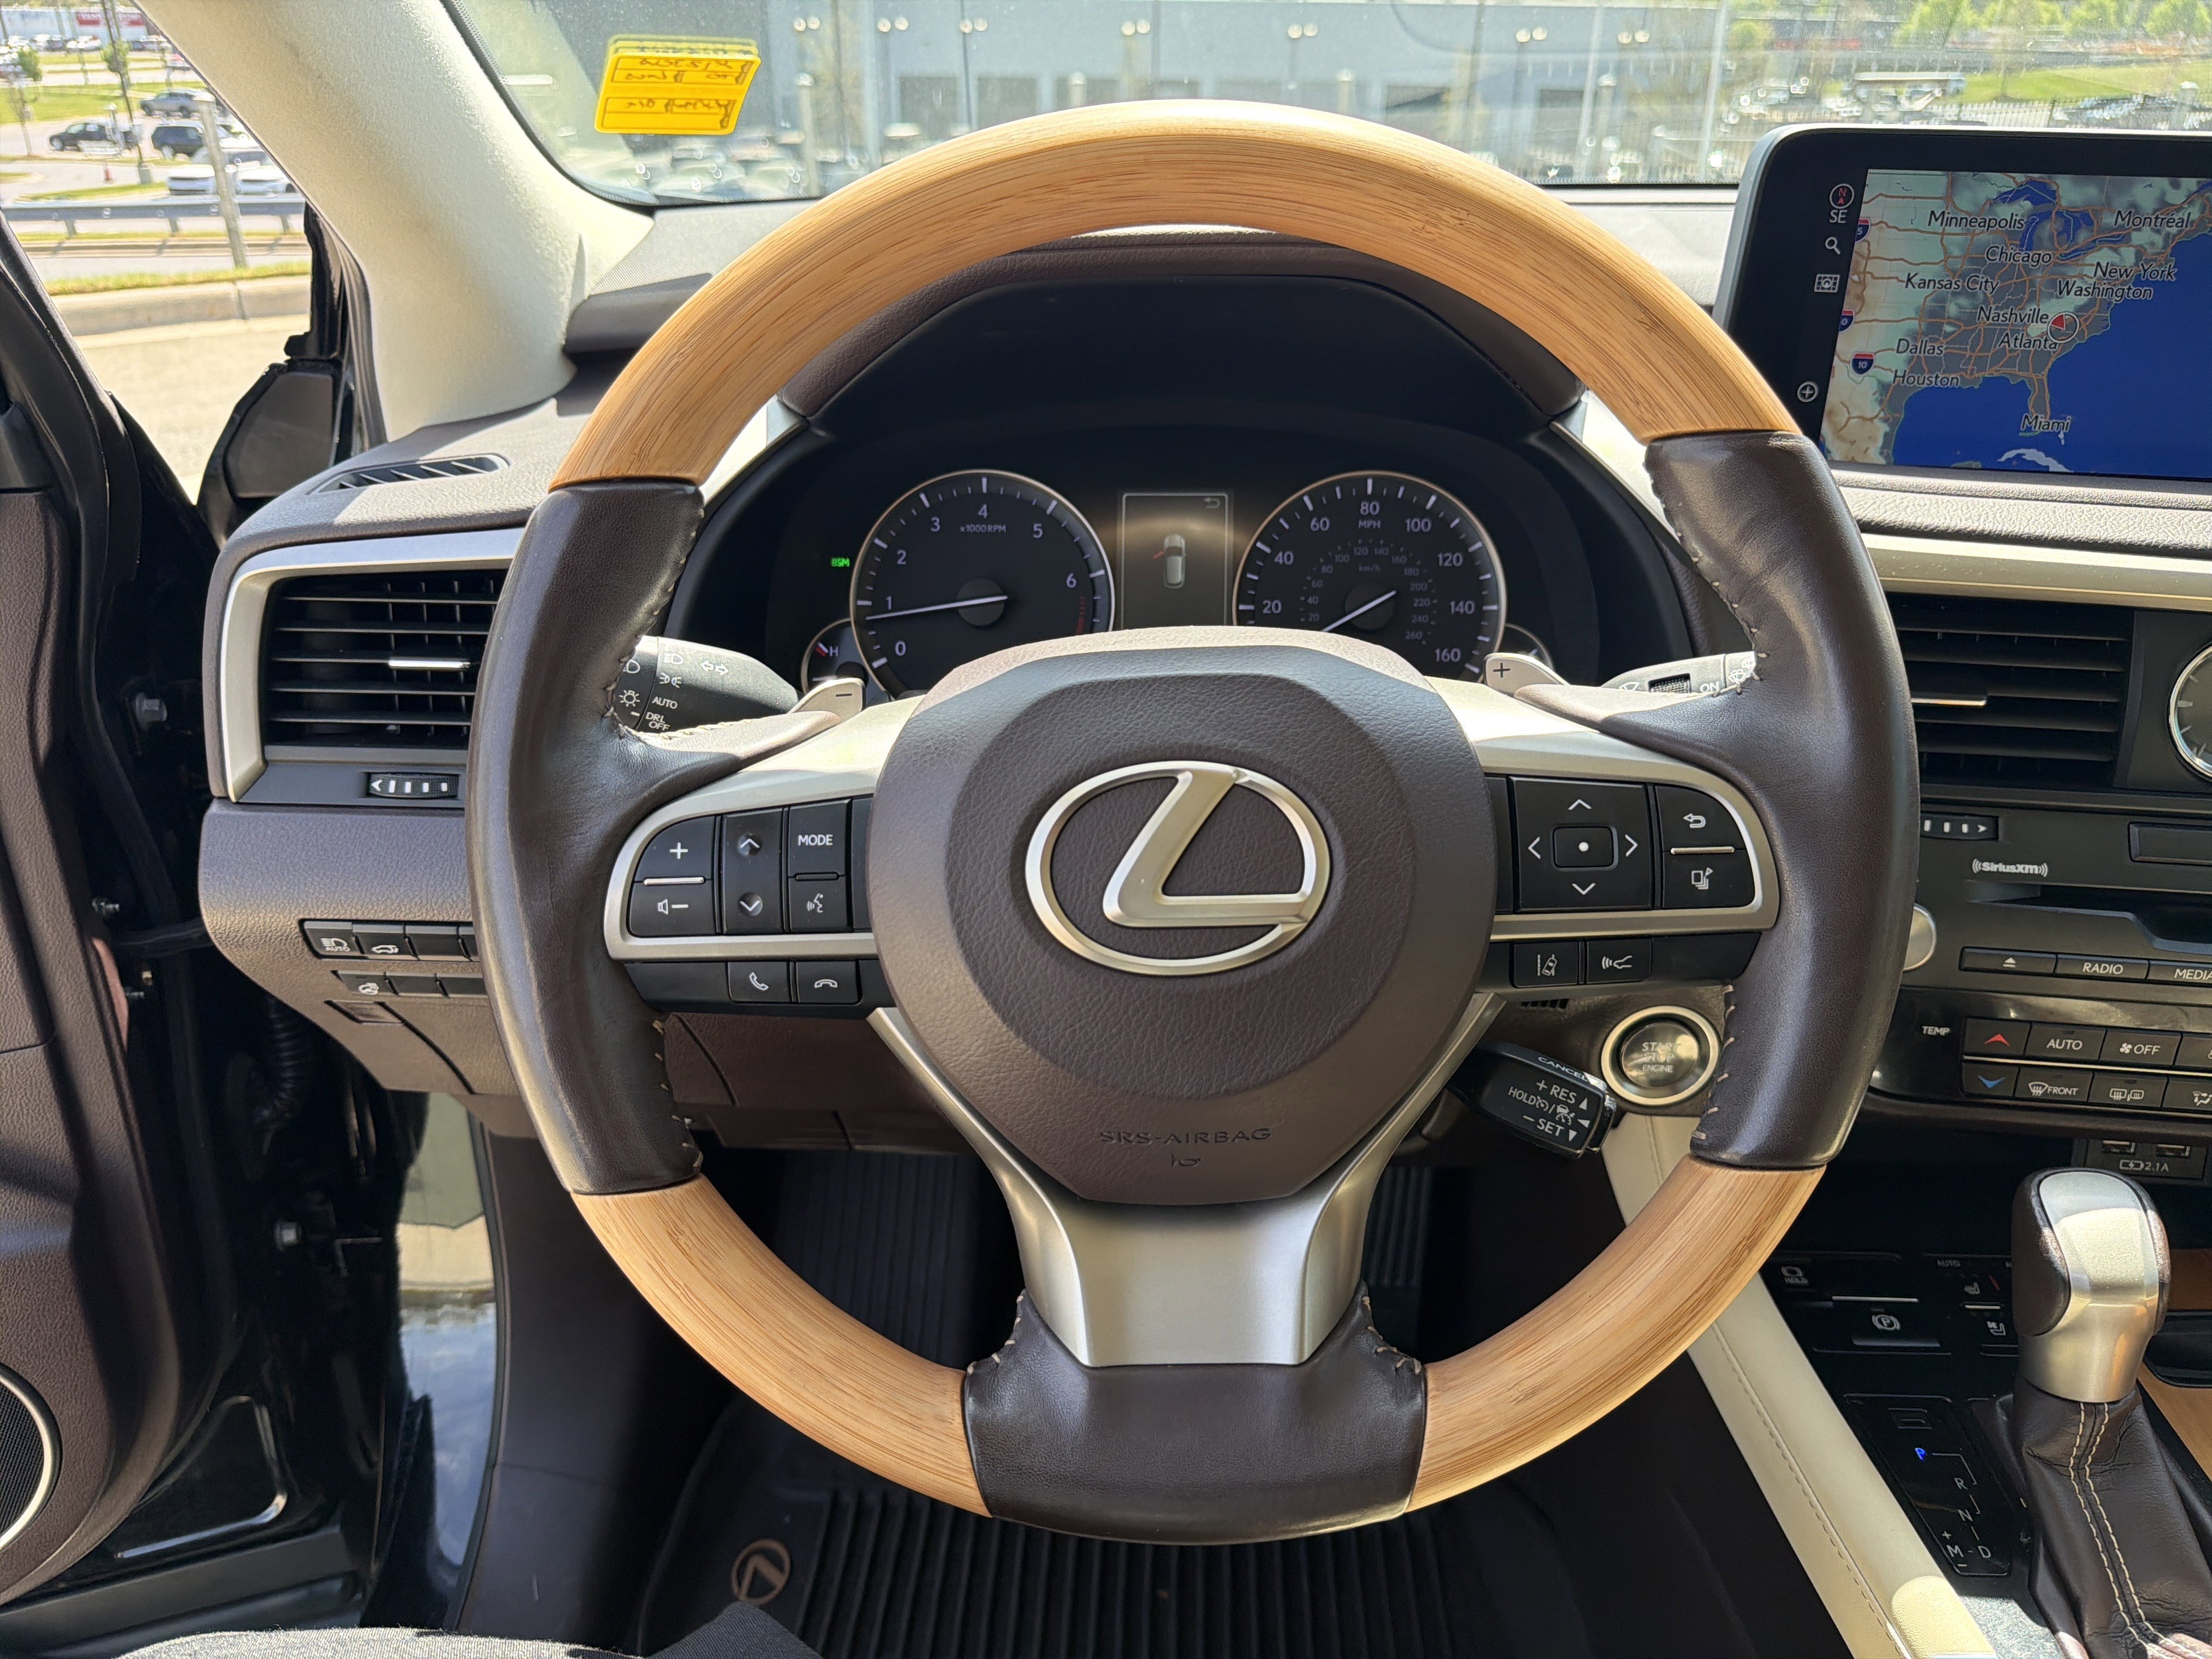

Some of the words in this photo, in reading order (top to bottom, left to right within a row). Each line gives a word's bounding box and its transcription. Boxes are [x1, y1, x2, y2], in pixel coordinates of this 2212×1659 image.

[1830, 210, 1847, 223] SE
[1928, 211, 2025, 230] Minneapolis
[2114, 210, 2191, 229] Montréal
[1985, 246, 2052, 266] Chicago
[2094, 262, 2133, 279] New
[2140, 264, 2176, 282] York
[1905, 273, 1961, 291] Kansas
[1966, 276, 2000, 295] City
[2057, 280, 2152, 300] Washington
[1977, 306, 2049, 325] Nashville
[1895, 339, 1944, 357] Dallas
[1999, 332, 2058, 351] Atlanta
[1893, 370, 1959, 388] Houston
[2021, 415, 2072, 432] Miami
[978, 504, 988, 518] 4
[1359, 501, 1380, 516] 80
[930, 517, 941, 532] 3
[1032, 523, 1043, 539] 5
[1310, 517, 1330, 532] 60
[1358, 519, 1381, 530] MPH
[1405, 518, 1432, 533] 100
[897, 550, 907, 566] 2
[1274, 551, 1294, 565] 40
[1437, 552, 1464, 567] 120
[1066, 573, 1076, 589] 6
[886, 596, 893, 610] 1
[1262, 600, 1283, 614] 20
[1449, 600, 1476, 614] 140
[829, 645, 839, 658] H
[895, 640, 906, 657] 0
[1435, 647, 1462, 662] 160
[1700, 681, 1720, 693] ON
[652, 696, 678, 709] AUTO
[645, 712, 666, 724] DRL
[648, 721, 670, 731] OFF
[798, 834, 833, 847] MODE
[2082, 961, 2124, 975] RADIO
[1922, 1025, 1951, 1036] TEMP
[2046, 1039, 2083, 1052] AUTO
[2133, 1043, 2161, 1056] OFF
[1643, 1052, 1674, 1063] STOP
[1537, 1056, 1589, 1082] CANCEL
[1642, 1064, 1674, 1074] ENGINE
[1507, 1085, 1537, 1106] HOLD
[1549, 1084, 1577, 1105] RES
[2047, 1085, 2079, 1097] FRONT
[1537, 1118, 1565, 1137] SET
[2144, 1161, 2169, 1173] 2.1A
[1954, 1477, 1968, 1491] R
[1957, 1509, 1973, 1522] N
[1946, 1544, 1965, 1558] M
[1978, 1545, 1992, 1559] D
